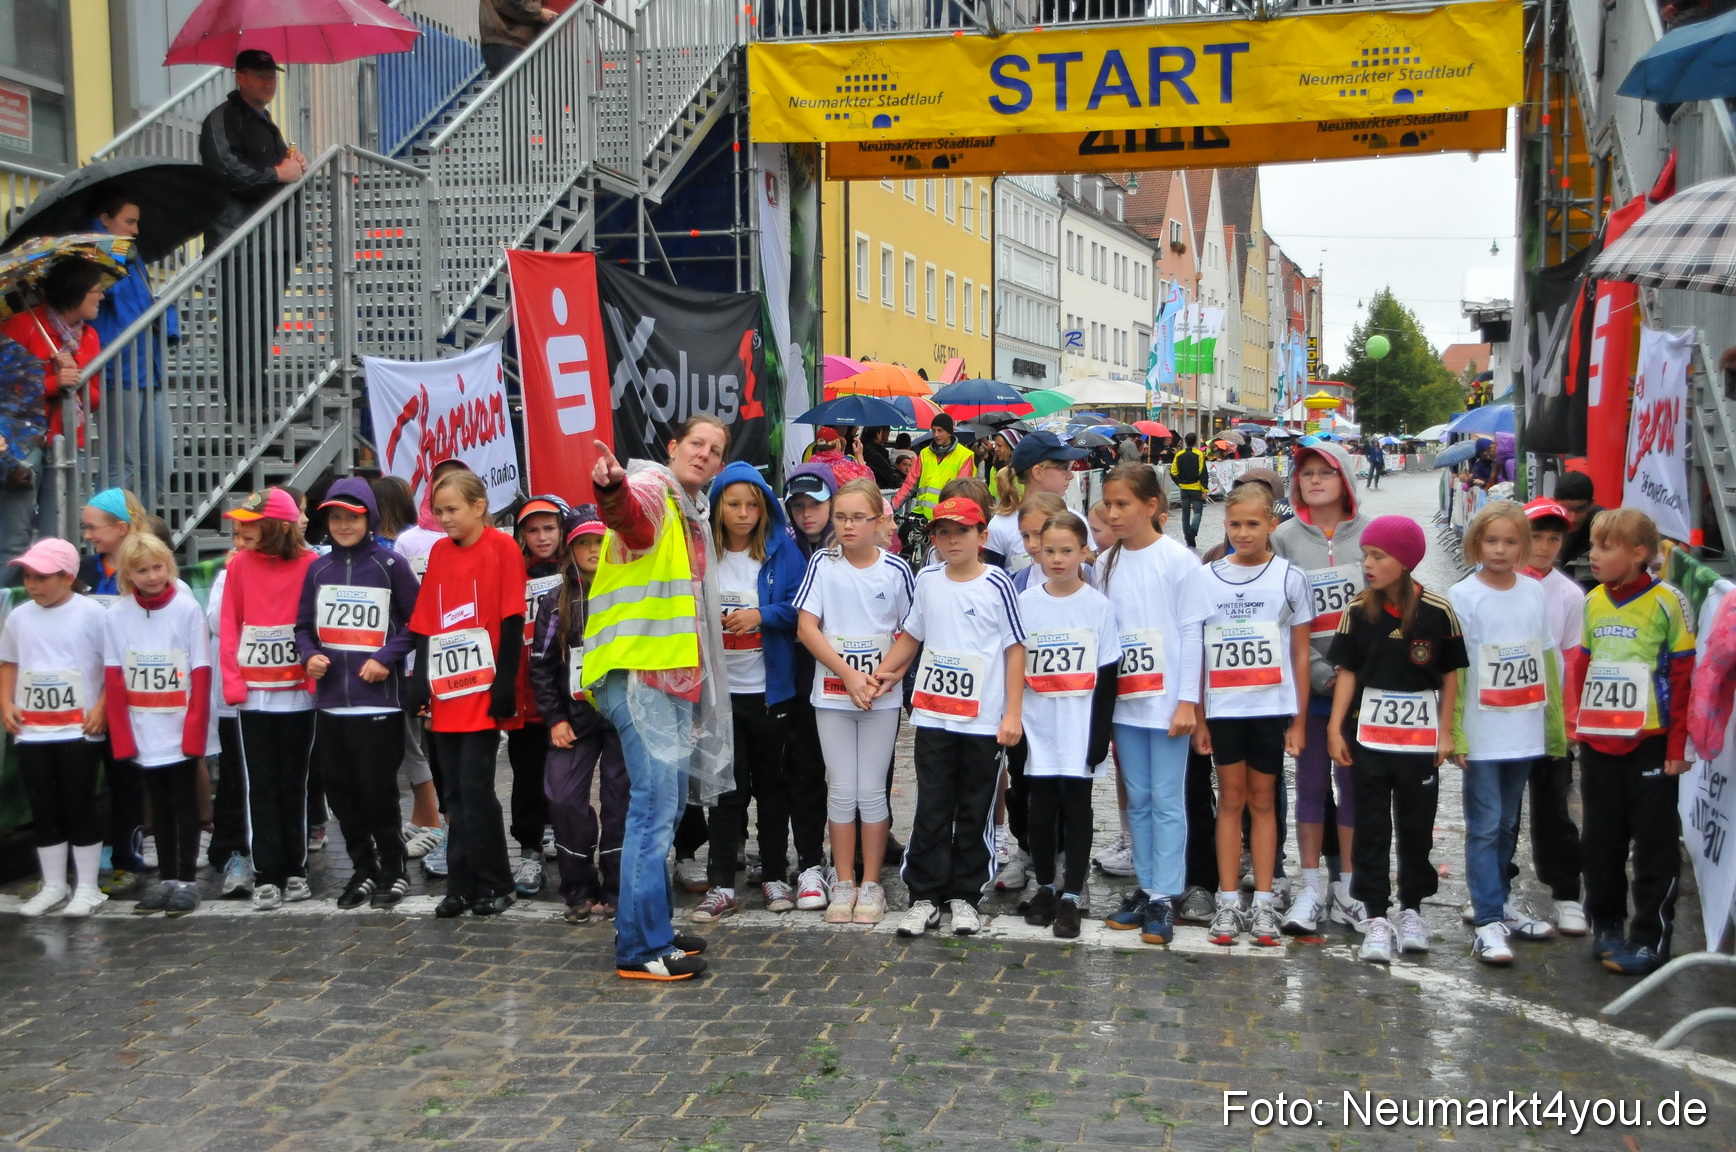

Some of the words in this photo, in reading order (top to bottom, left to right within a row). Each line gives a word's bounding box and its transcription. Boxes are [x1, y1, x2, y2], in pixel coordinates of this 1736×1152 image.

[988, 41, 1250, 116] START
[1298, 69, 1395, 87] Neumarkter
[1398, 62, 1475, 81] Stadtlauf
[787, 95, 873, 109] Neumarkter
[877, 91, 944, 108] Stadtlauf
[1316, 115, 1402, 133] Neumarkter
[857, 140, 932, 152] Neumarkter
[934, 135, 997, 150] Stadtlauf
[491, 460, 517, 487] Radio
[325, 602, 381, 629] 7290
[1037, 633, 1070, 643] BOCK
[1222, 627, 1254, 637] BOCK
[1593, 624, 1638, 638] BOCK
[246, 641, 299, 665] 7303
[843, 640, 873, 648] BOCK
[1211, 640, 1273, 668] 7365
[432, 644, 484, 676] 7071
[1028, 647, 1086, 674] 7237
[1487, 657, 1539, 687] 7249
[129, 667, 181, 690] 7154
[447, 674, 478, 690] Leonie
[922, 665, 974, 697] 7339
[24, 685, 76, 710] 7304
[1584, 681, 1637, 709] 7240
[1369, 698, 1430, 726] 7324
